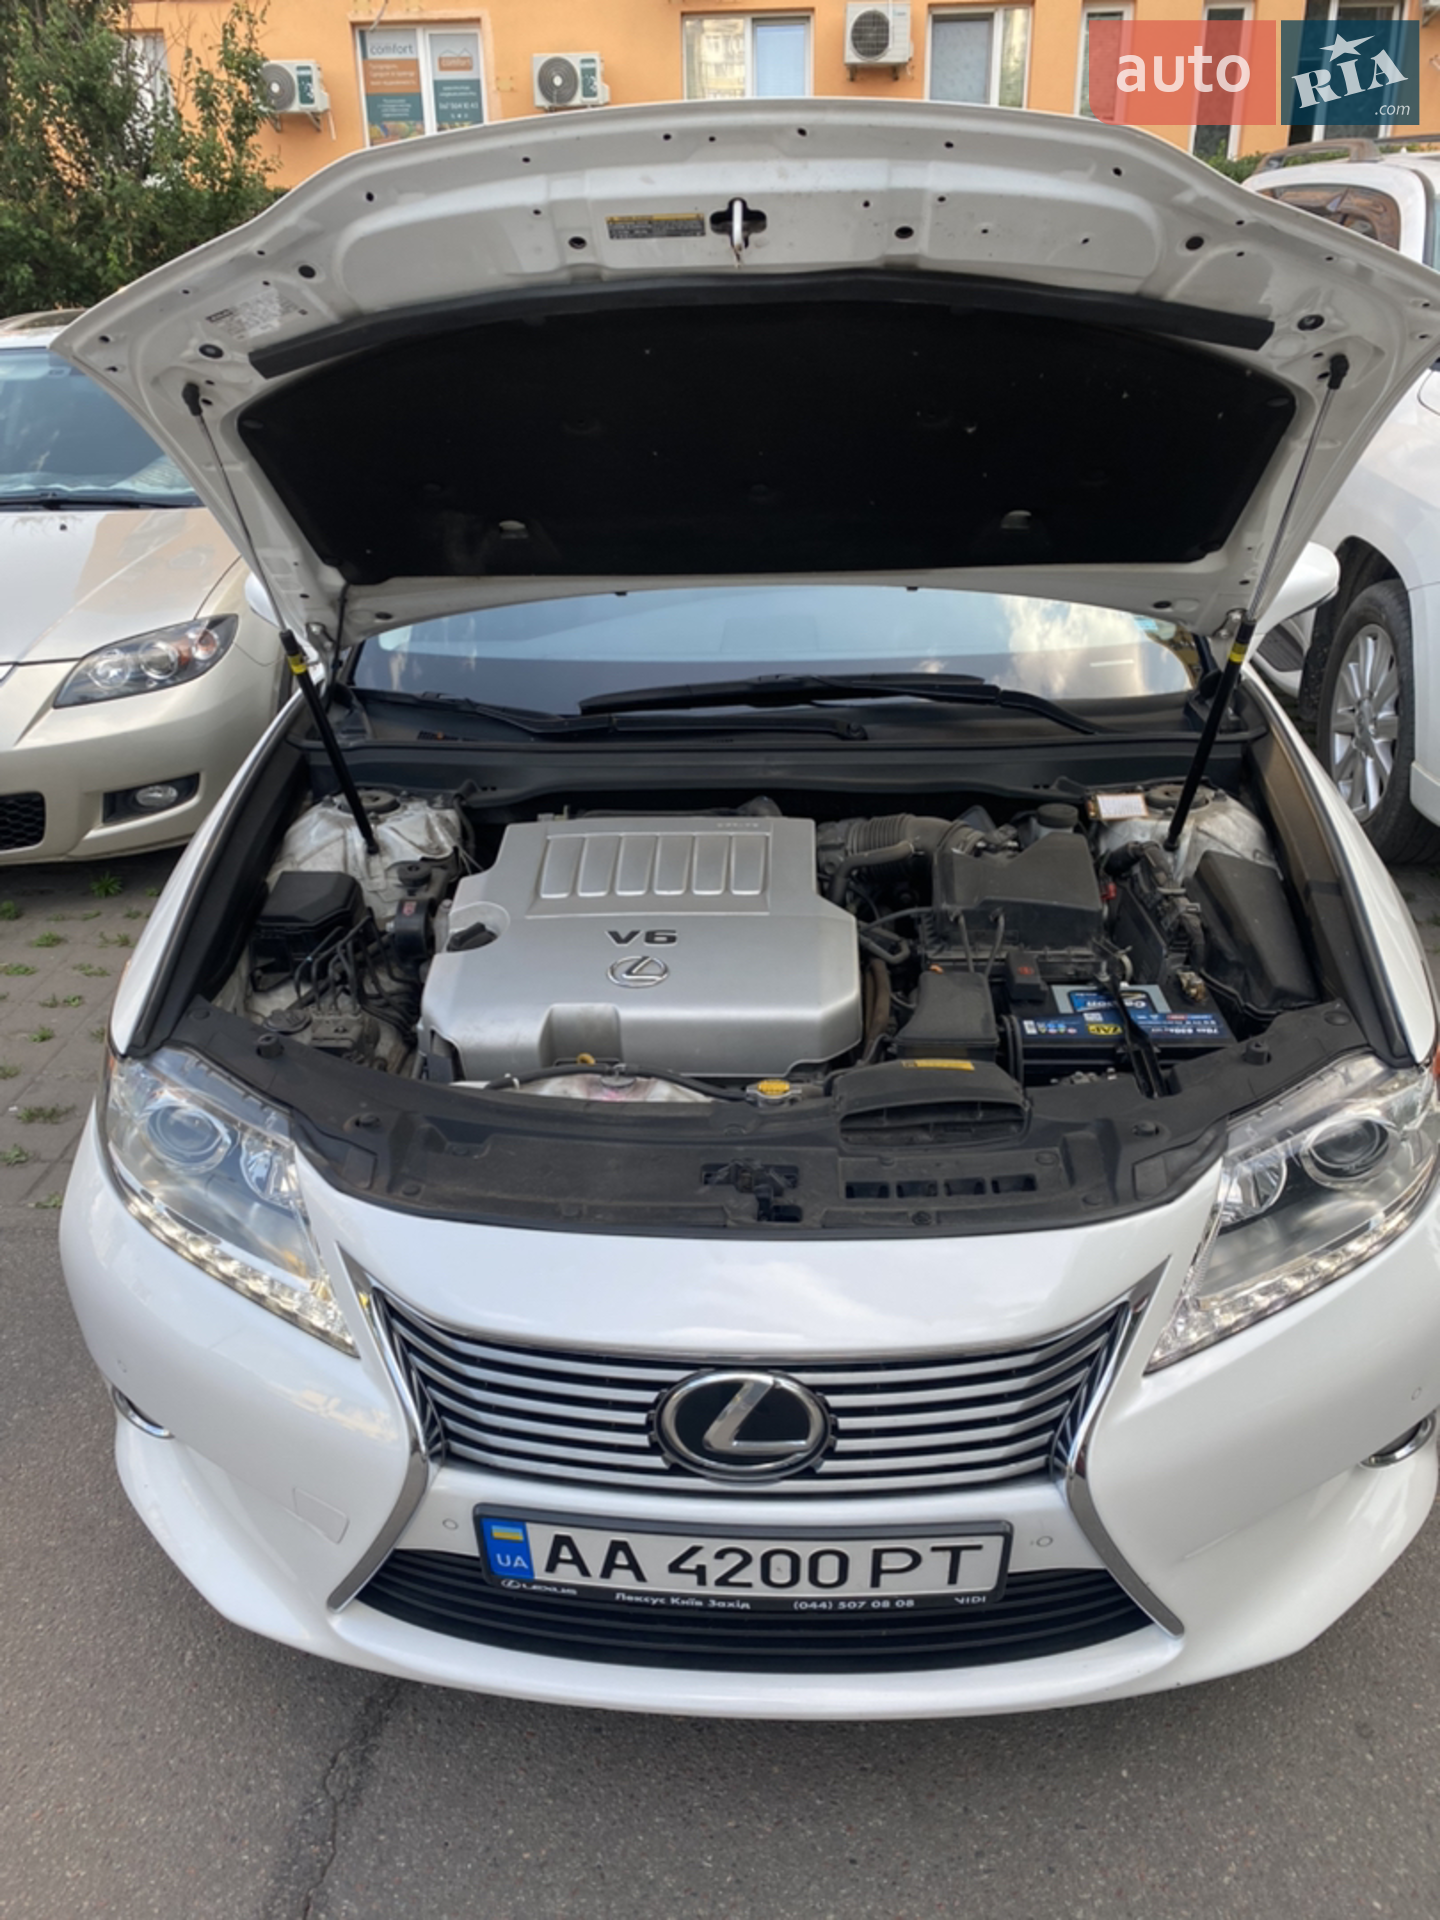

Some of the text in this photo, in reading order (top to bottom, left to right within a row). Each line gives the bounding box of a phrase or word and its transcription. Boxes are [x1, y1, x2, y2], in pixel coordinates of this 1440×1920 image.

[370, 43, 414, 55] comfort
[605, 929, 678, 946] V6
[1086, 1000, 1146, 1009] Caon
[496, 1553, 528, 1569] UA
[544, 1533, 984, 1589] AA 4200 PT
[522, 1583, 578, 1596] LEXUS
[614, 1592, 666, 1606] Лексус
[707, 1599, 751, 1610] Захід
[793, 1599, 915, 1611] (044) 507 08 08
[954, 1596, 987, 1605] VIDI
